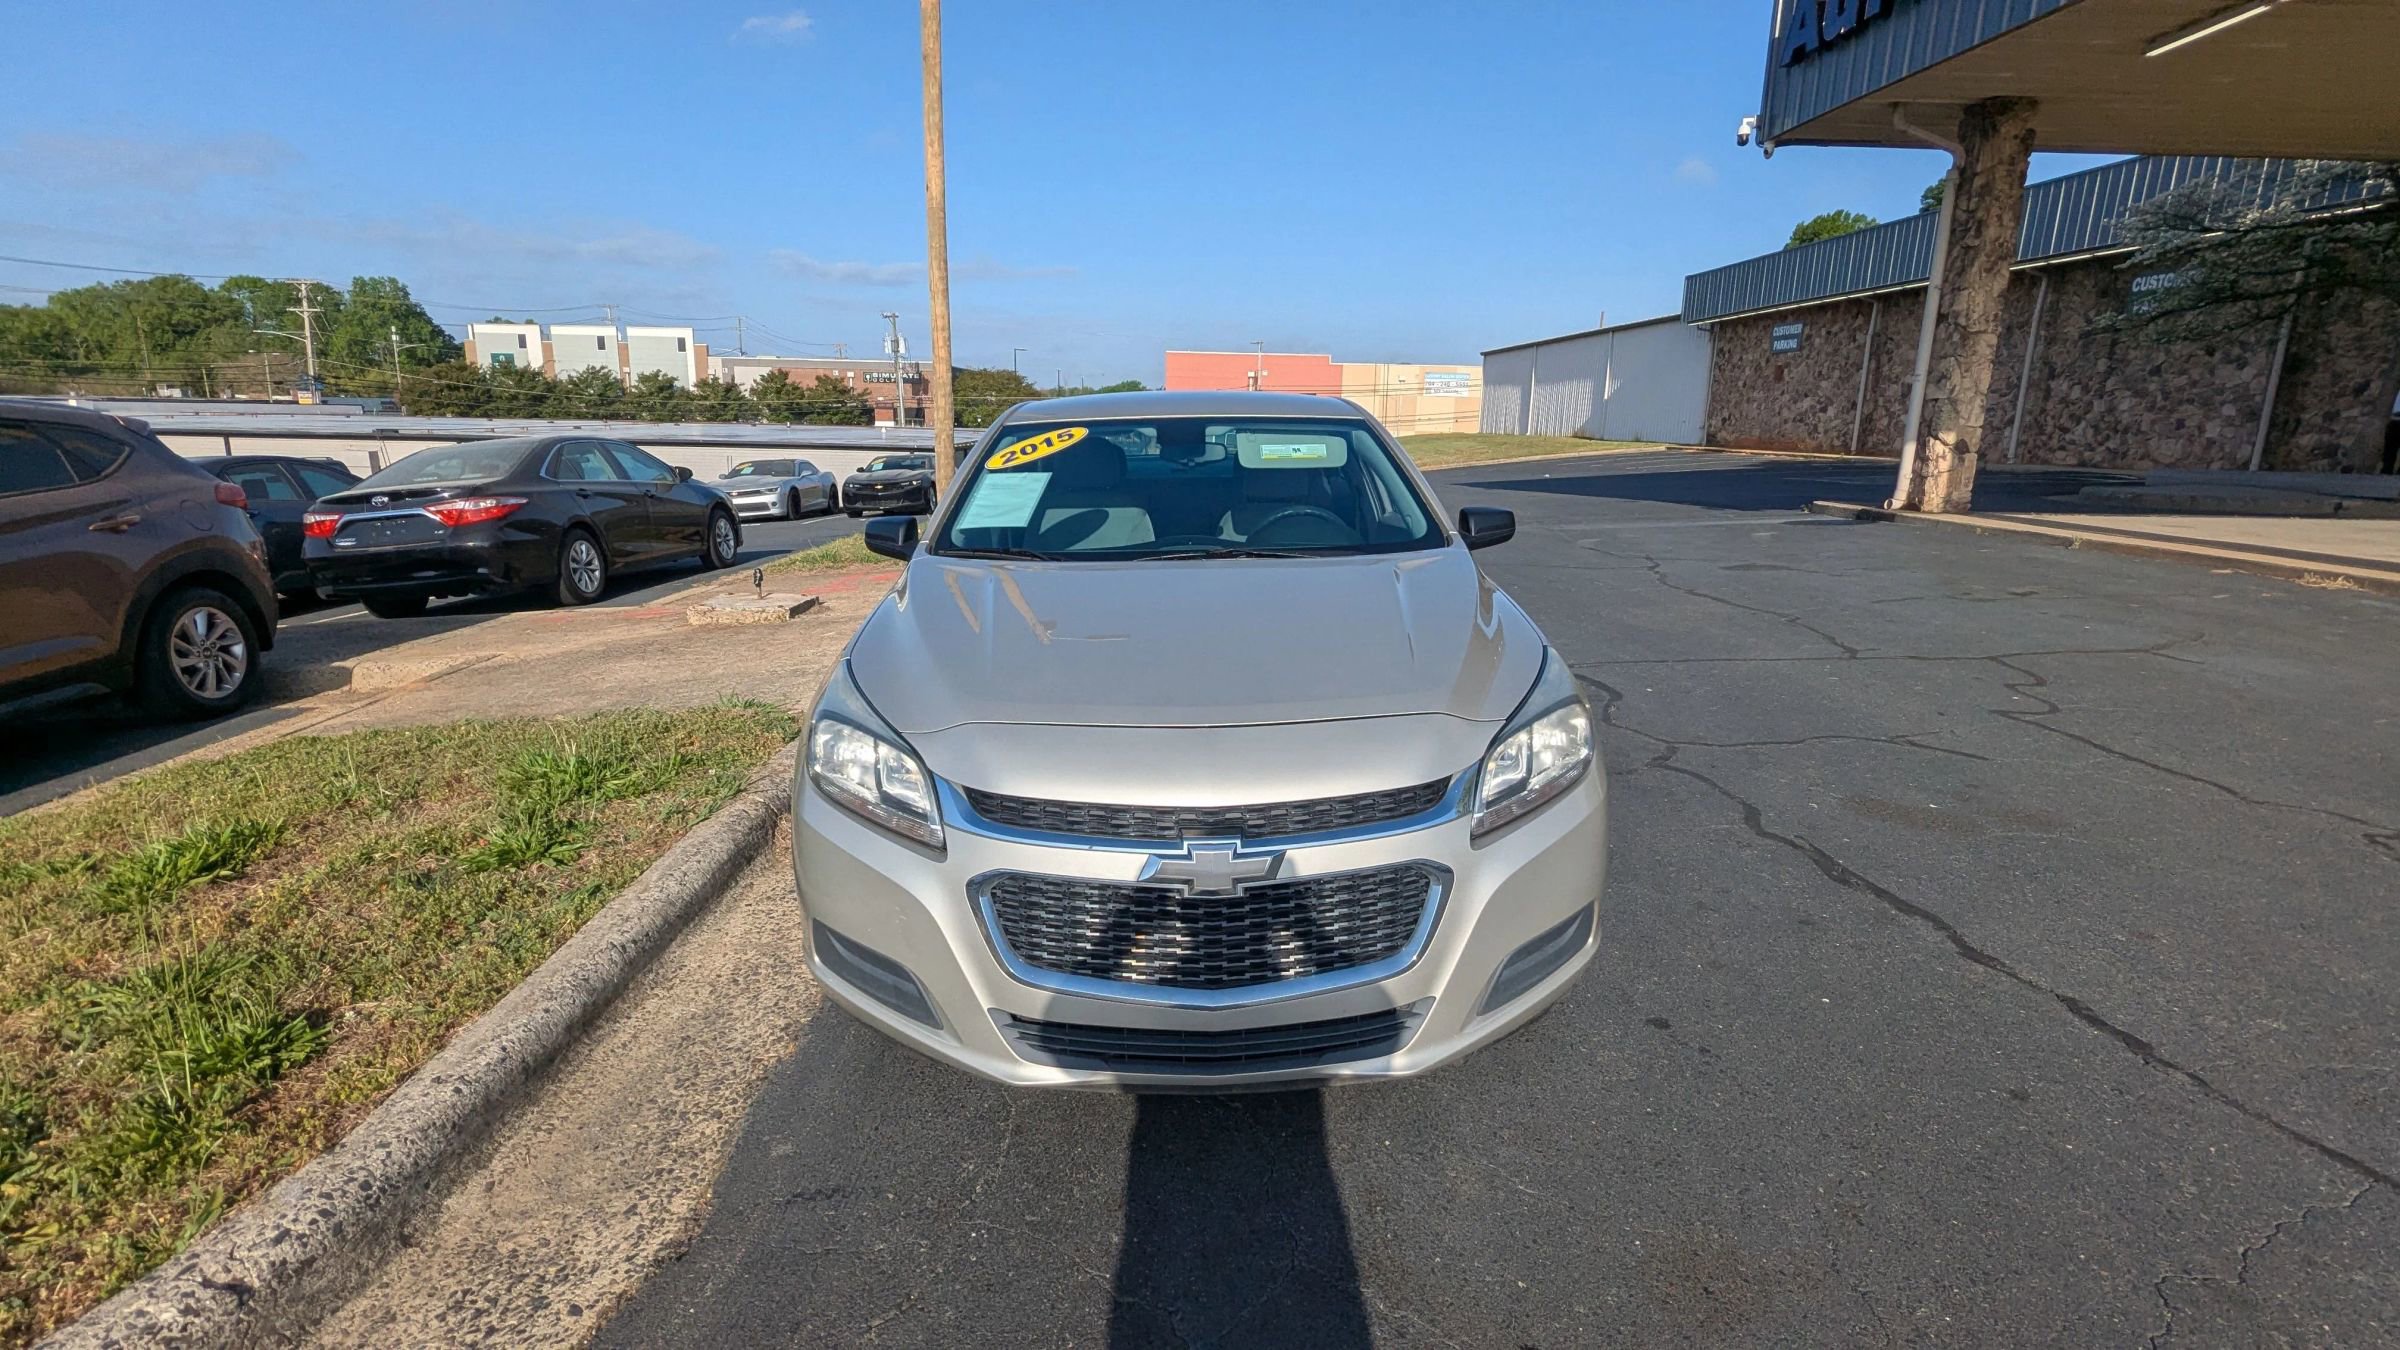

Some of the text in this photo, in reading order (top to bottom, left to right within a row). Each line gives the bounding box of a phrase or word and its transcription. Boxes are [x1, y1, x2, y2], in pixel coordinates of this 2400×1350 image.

[1781, 0, 1881, 66] Au
[1773, 324, 1803, 336] CUSTOMER
[1773, 339, 1798, 350] PARKING
[1000, 430, 1075, 466] 2015
